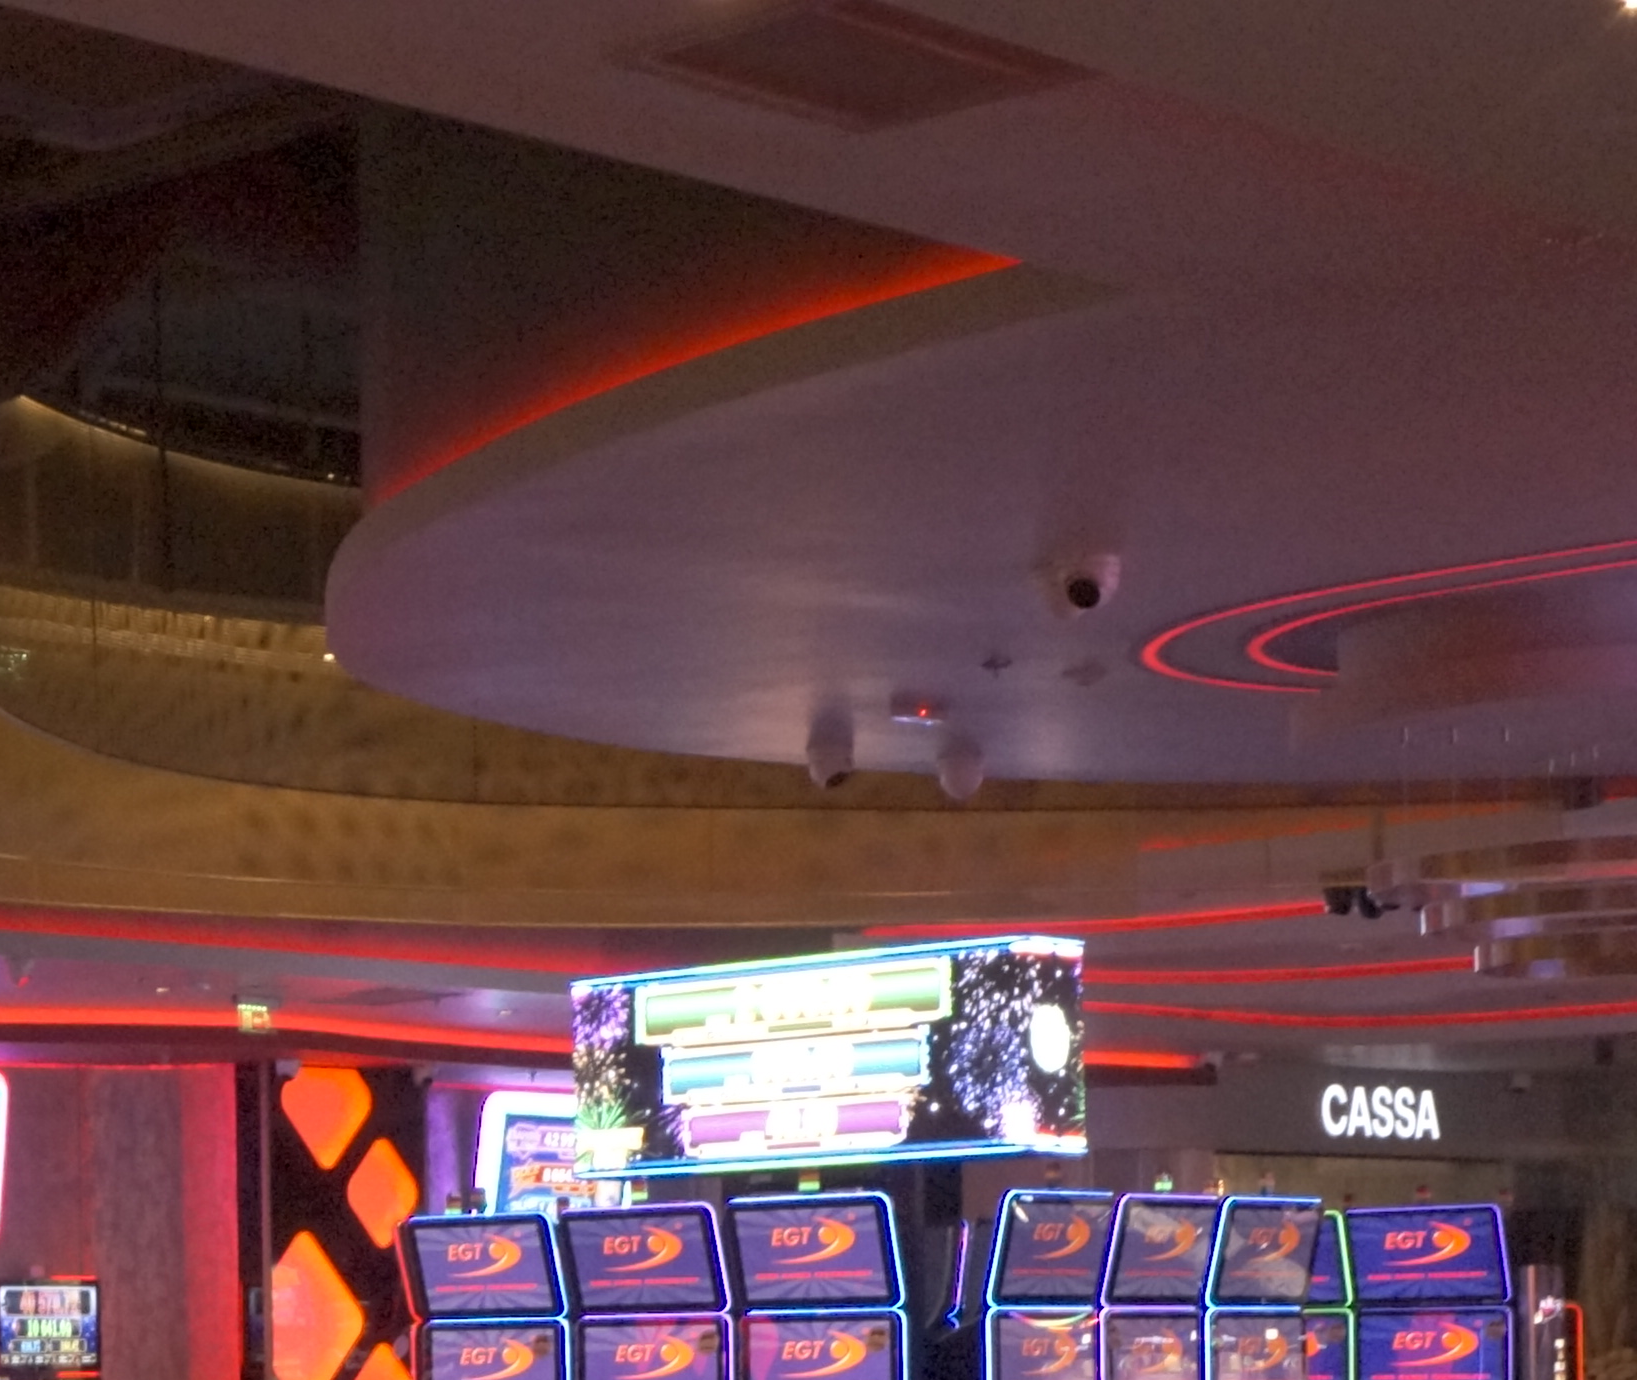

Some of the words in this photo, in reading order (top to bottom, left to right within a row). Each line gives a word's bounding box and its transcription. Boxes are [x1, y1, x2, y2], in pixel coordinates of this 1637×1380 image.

[1322, 1084, 1440, 1139] CASSA
[603, 1236, 641, 1255] EGT
[771, 1227, 812, 1247] EGT
[1384, 1230, 1428, 1251] EGT
[447, 1243, 483, 1262] EGT
[782, 1340, 824, 1361] EGT
[1392, 1330, 1437, 1351] EGT
[459, 1347, 496, 1366] EGT
[615, 1344, 655, 1363] EGT
